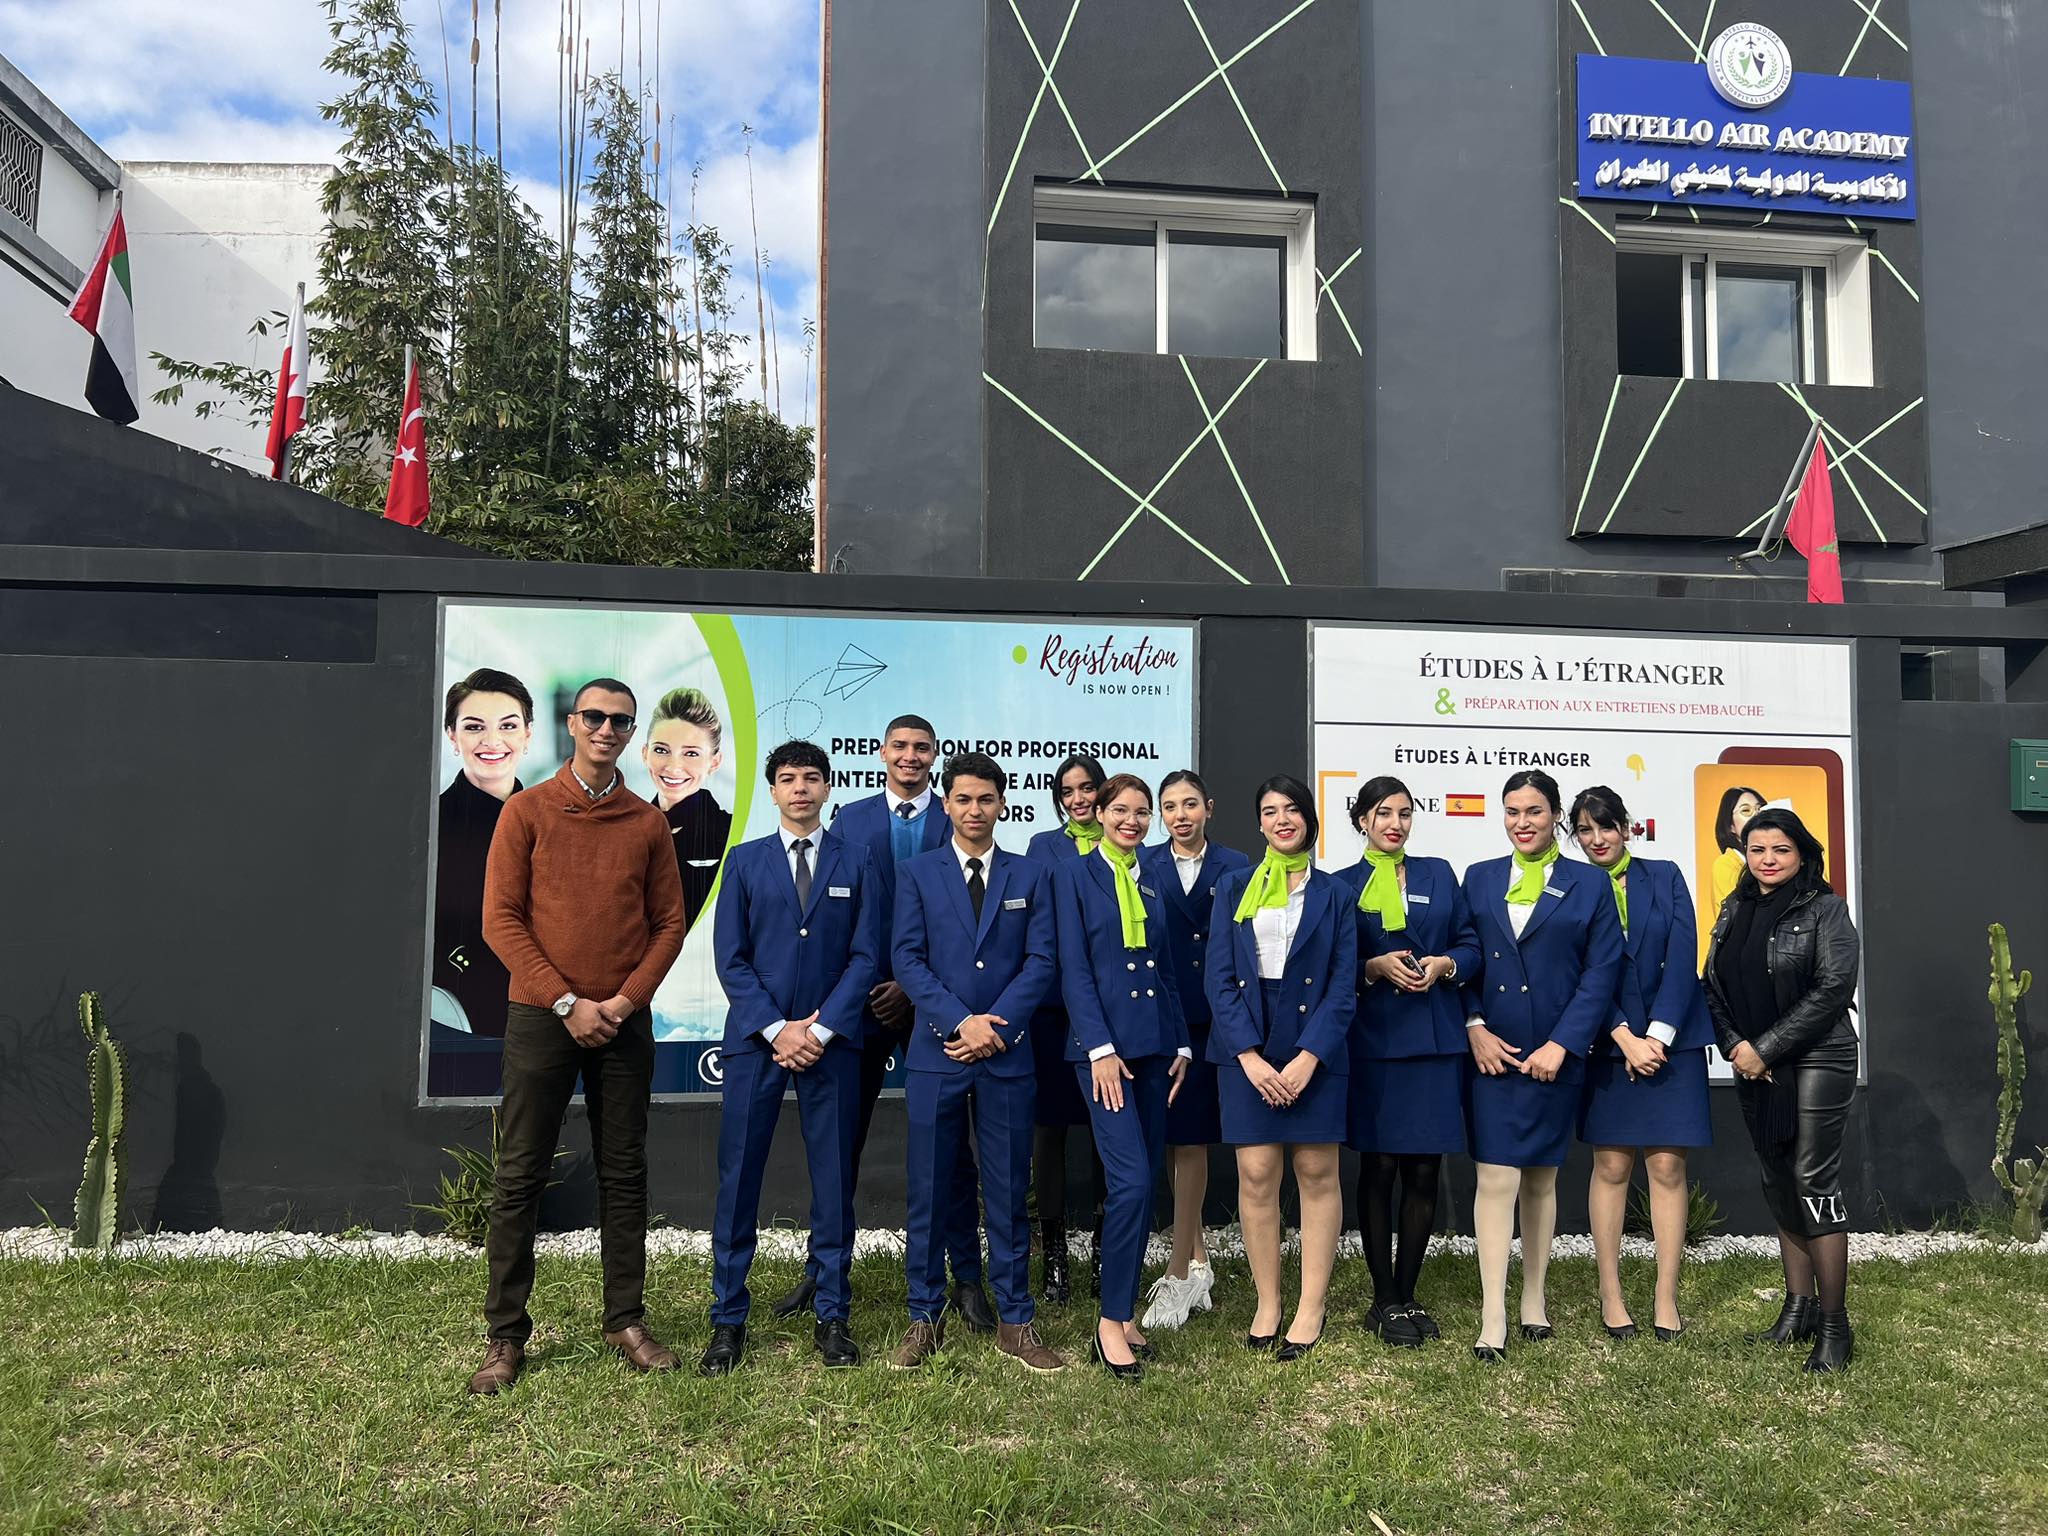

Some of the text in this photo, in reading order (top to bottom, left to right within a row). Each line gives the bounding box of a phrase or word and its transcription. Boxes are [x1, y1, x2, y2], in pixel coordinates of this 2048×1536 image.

[1722, 24, 1749, 40] INTELLO
[1724, 82, 1771, 103] HOSPITALITY
[1773, 65, 1791, 97] ACADEMY
[1588, 113, 1909, 159] INTELLO AIR ACADEMY
[1595, 158, 1670, 187] الطيران
[1735, 166, 1810, 197] الدولية
[1040, 634, 1179, 686] Registration
[1419, 652, 1725, 686] ÉTUDES À L’ÉTRANGER
[1083, 684, 1094, 694] IS
[1100, 685, 1126, 695] NOW
[1131, 685, 1161, 695] OPEN
[1434, 687, 1765, 717] & PRÉPARATION AUX ENTRETIENS D'EMBAUCHE
[832, 738, 1159, 759] PREPION FOR PROFESSIONAL
[1395, 744, 1591, 767] ÉTUDES À L’ÉTRANGER
